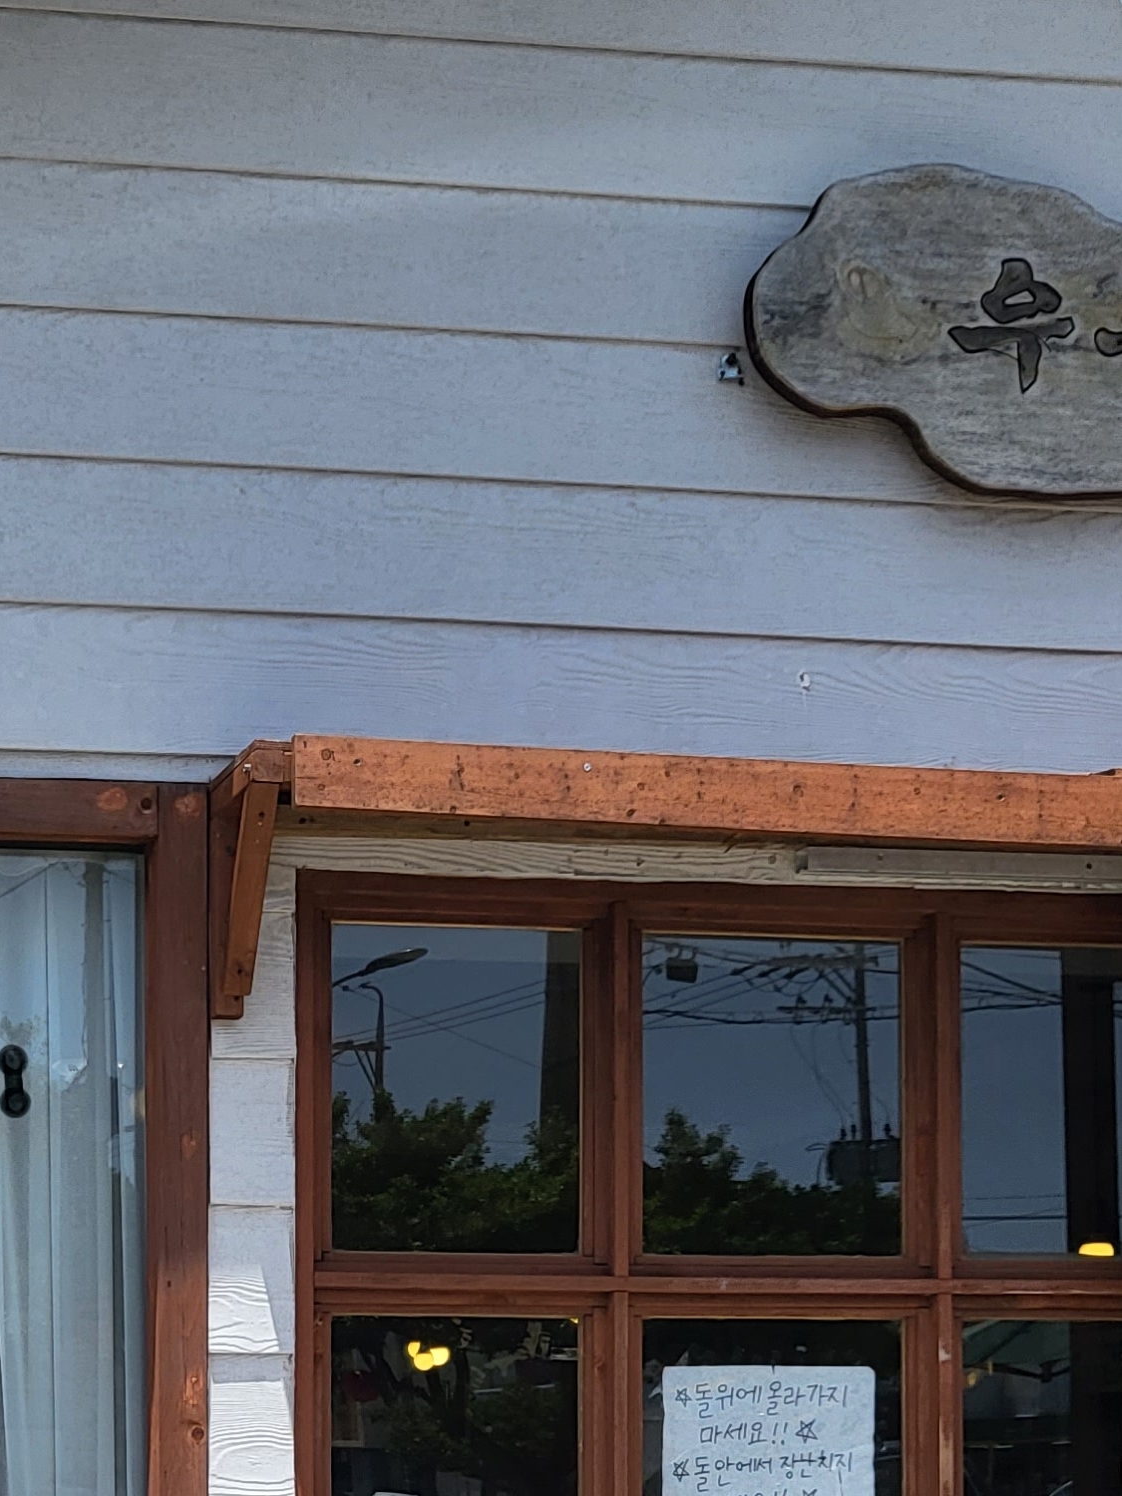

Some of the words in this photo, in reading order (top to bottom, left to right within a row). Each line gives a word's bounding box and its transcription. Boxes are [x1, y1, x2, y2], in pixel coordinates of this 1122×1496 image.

[948, 257, 1122, 394] 우
[766, 1380, 848, 1416] 올라가지
[699, 1421, 789, 1446] 마세요!!
